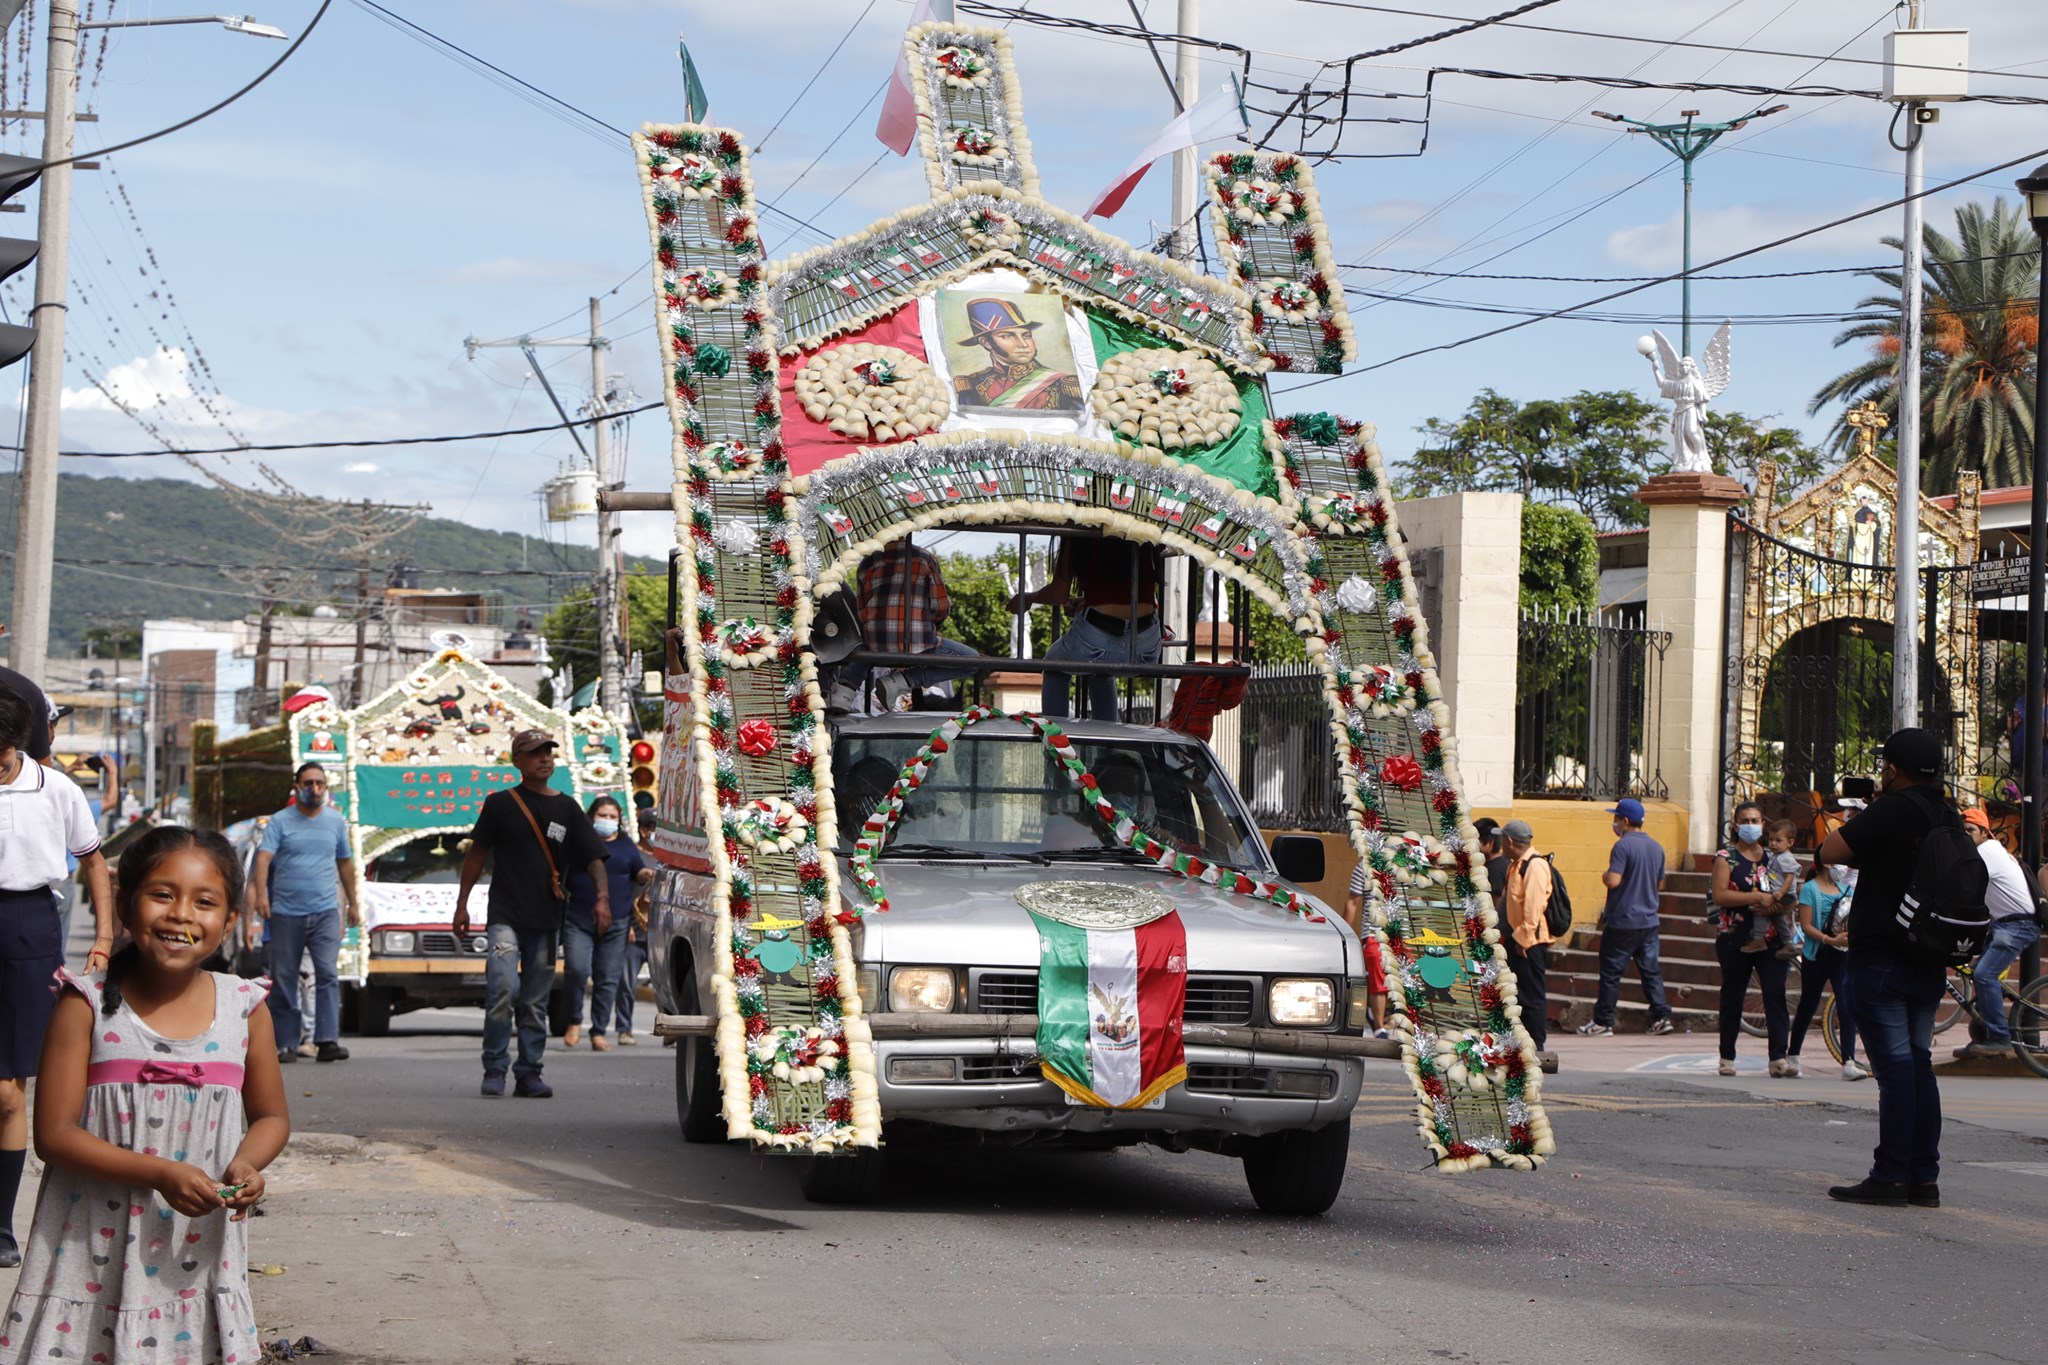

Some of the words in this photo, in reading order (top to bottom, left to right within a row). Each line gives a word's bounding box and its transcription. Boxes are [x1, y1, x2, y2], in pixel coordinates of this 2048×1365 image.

[819, 235, 945, 299] VIVA
[1036, 235, 1211, 333] MEXICO
[1069, 467, 1271, 560] TOMAS
[1980, 560, 2005, 571] PROHIBE
[2006, 559, 2014, 568] LA
[2015, 556, 2030, 567] ENTR
[1972, 569, 2007, 581] VENDEDORES
[2008, 566, 2030, 577] AMBULA
[402, 771, 452, 784] SAN
[470, 769, 523, 784] JUA
